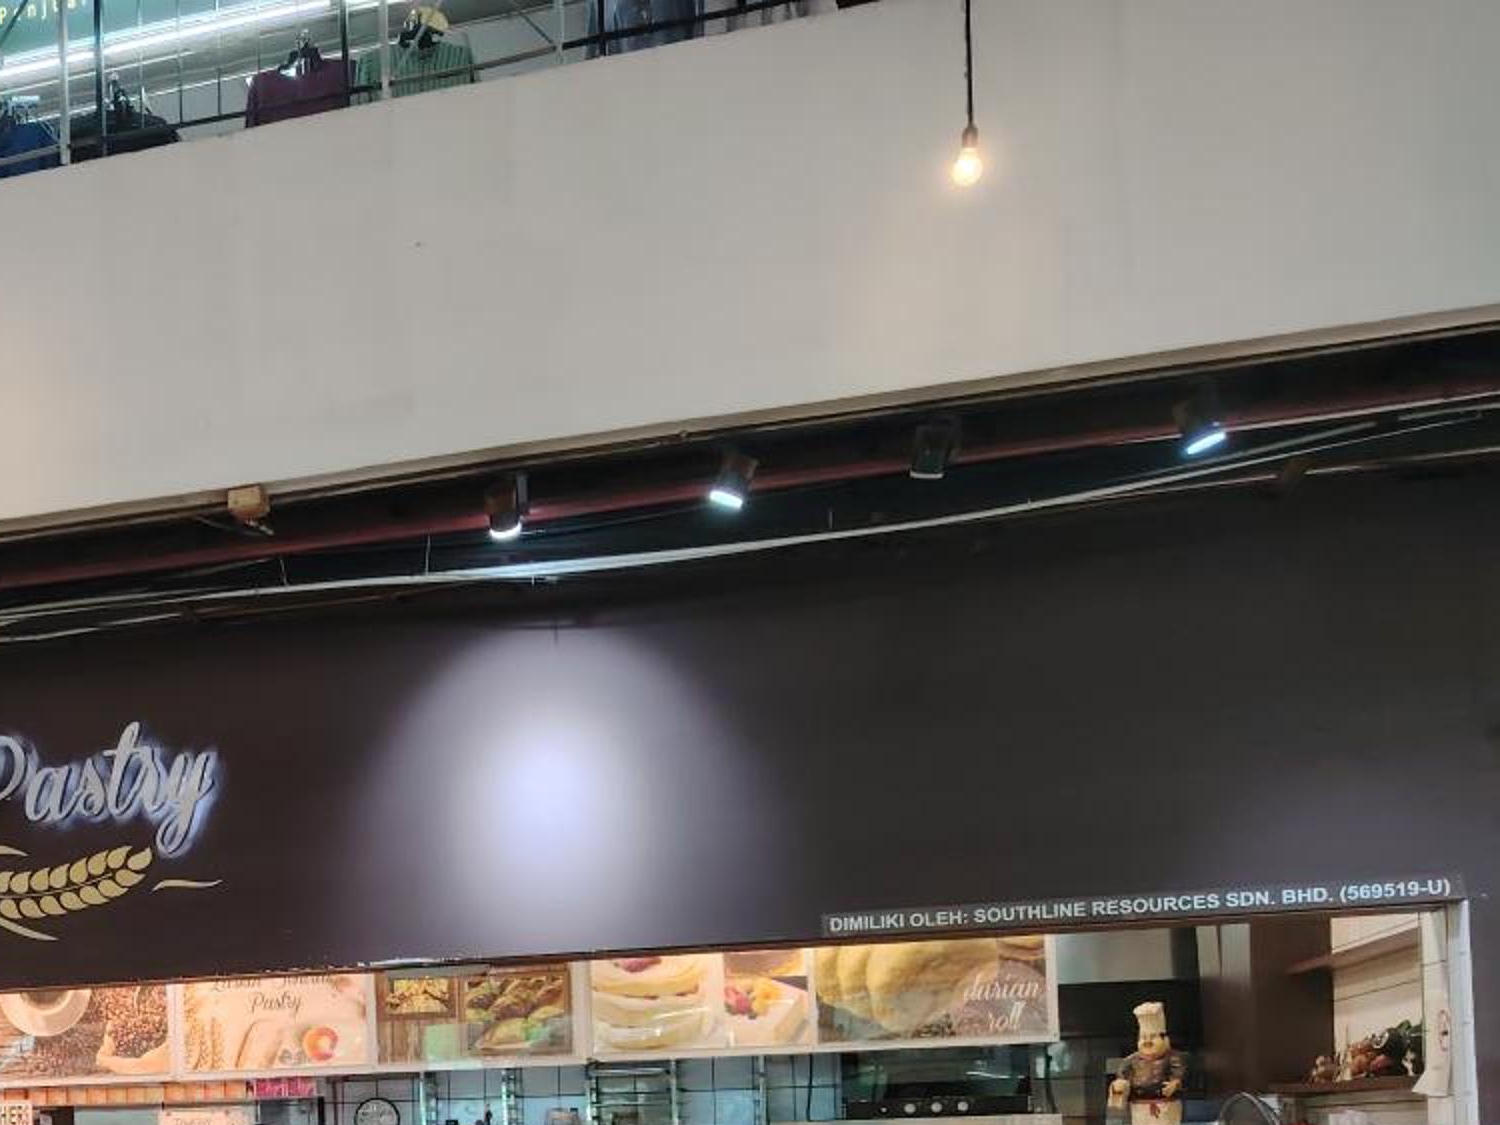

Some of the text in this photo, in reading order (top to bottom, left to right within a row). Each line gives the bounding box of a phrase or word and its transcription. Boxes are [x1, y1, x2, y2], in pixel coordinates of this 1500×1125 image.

[830, 877, 1450, 932] DIMILIKI OLEH: SOUTHLINE RESOURCES SDN. BHD. (569519-U)
[963, 973, 1040, 1000] durian
[988, 1001, 1026, 1032] roll
